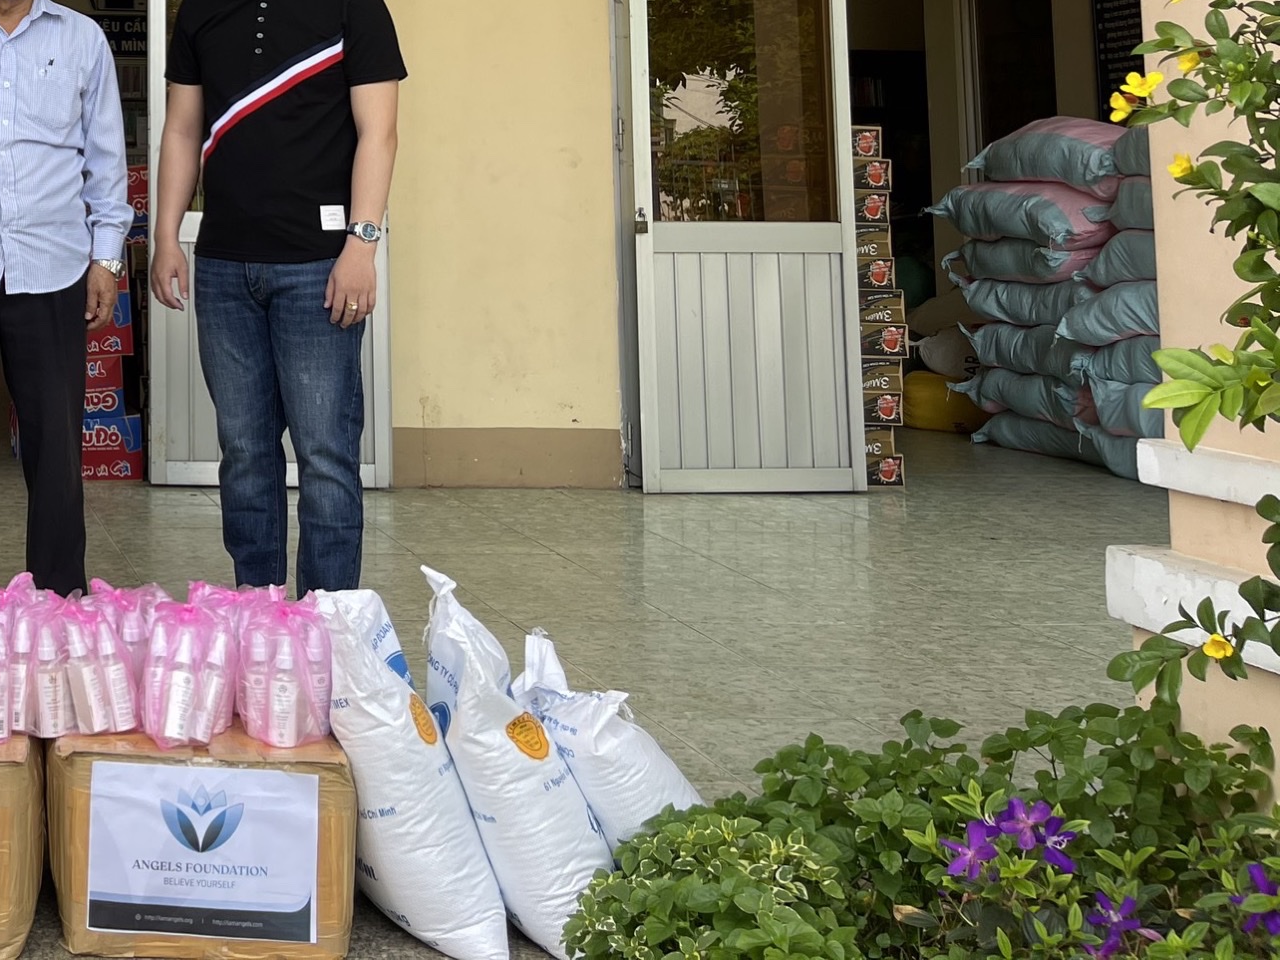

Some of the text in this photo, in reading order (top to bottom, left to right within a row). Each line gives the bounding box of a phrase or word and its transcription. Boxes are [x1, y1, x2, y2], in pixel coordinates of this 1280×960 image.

[121, 37, 146, 51] MÌN
[427, 650, 440, 671] ÔNG
[132, 859, 269, 877] ANGELS FOUNDATION
[163, 877, 236, 889] BELIEVE YOURSELF
